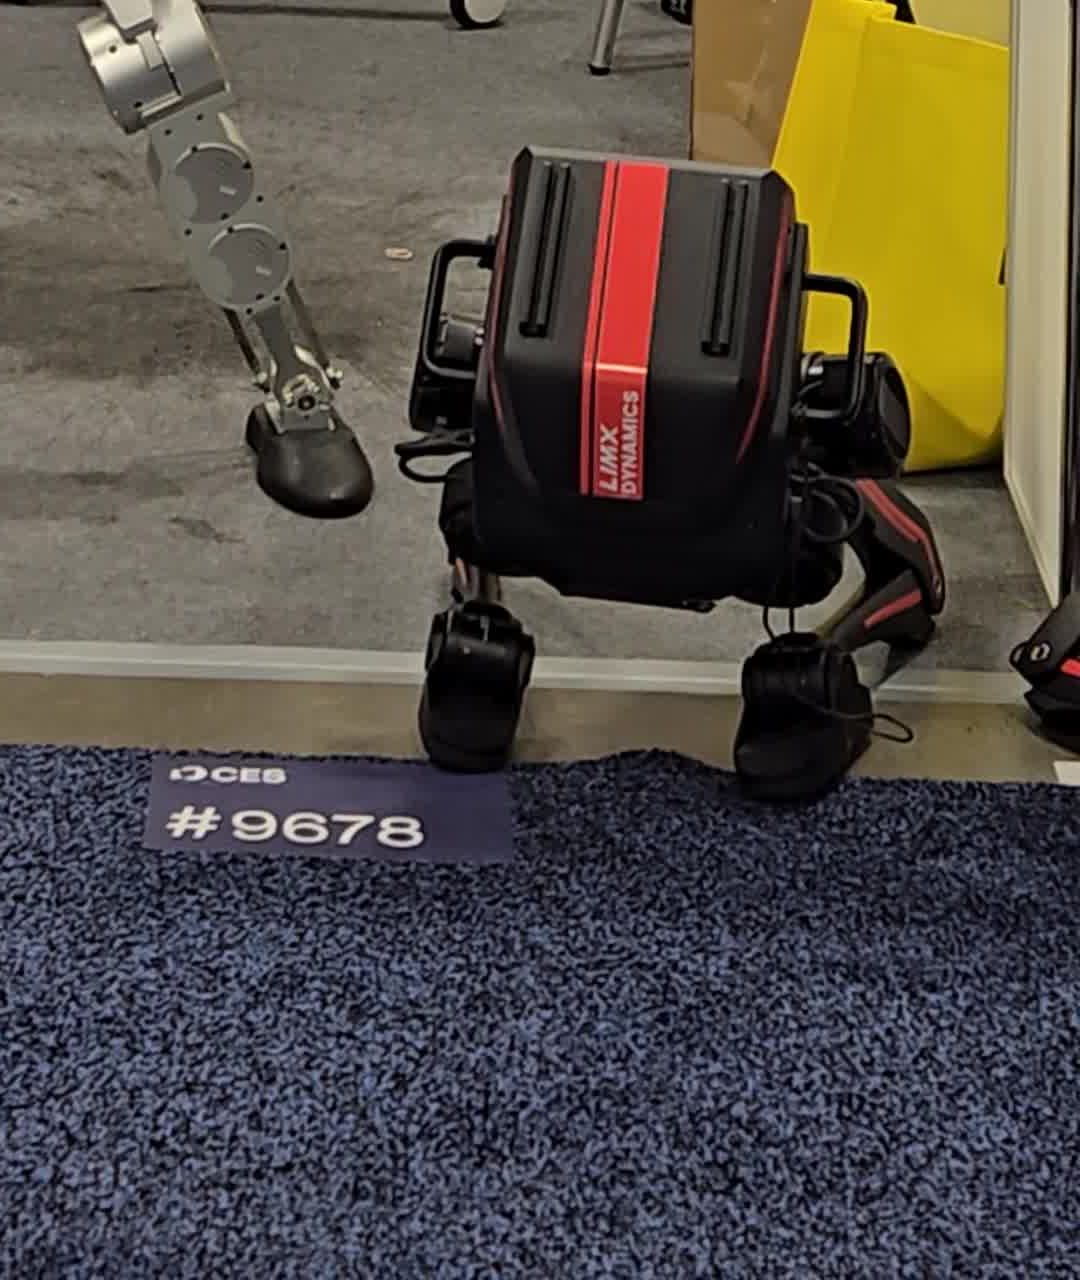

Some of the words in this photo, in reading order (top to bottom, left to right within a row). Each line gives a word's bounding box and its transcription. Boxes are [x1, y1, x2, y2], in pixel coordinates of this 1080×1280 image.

[599, 423, 619, 493] LIMX
[620, 390, 640, 495] DYNAMICS
[165, 805, 425, 849] #9678
